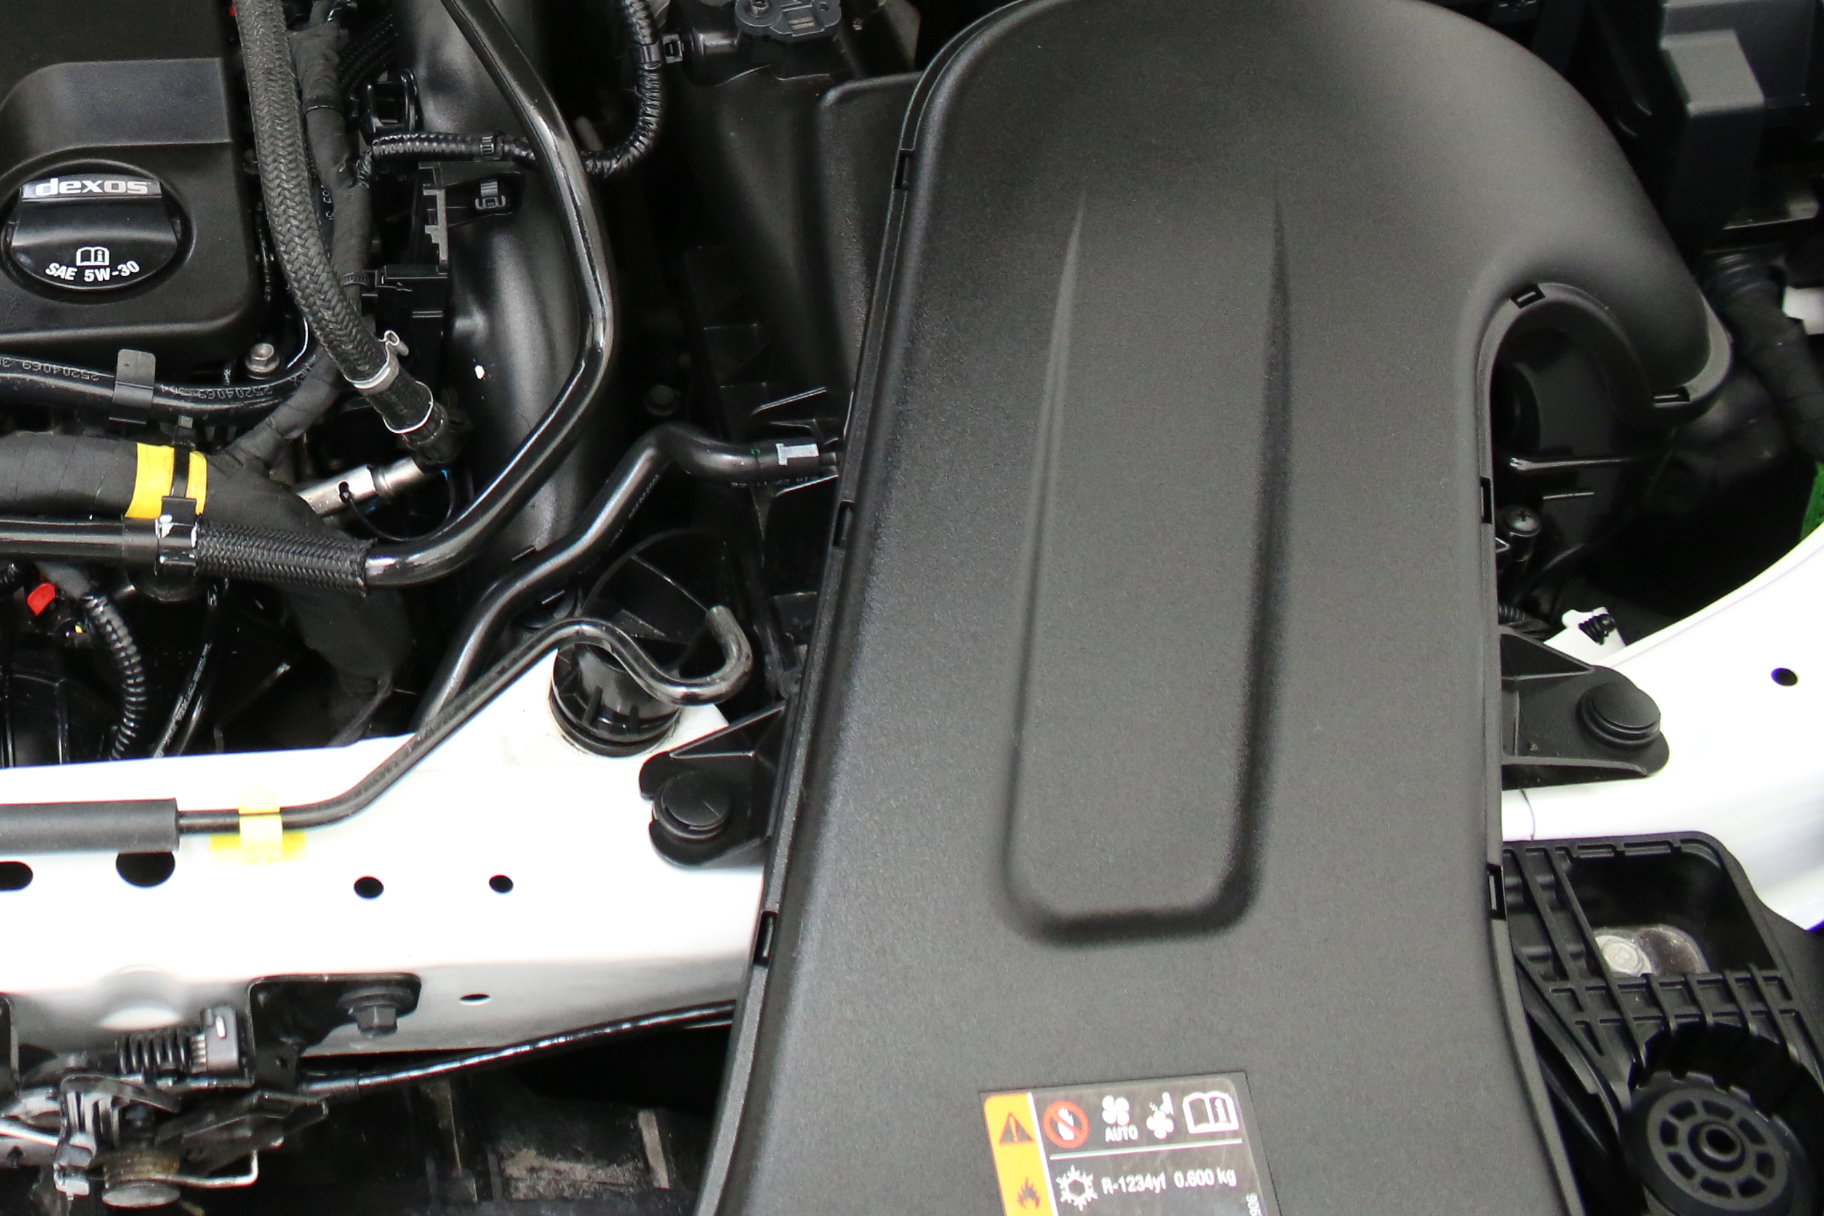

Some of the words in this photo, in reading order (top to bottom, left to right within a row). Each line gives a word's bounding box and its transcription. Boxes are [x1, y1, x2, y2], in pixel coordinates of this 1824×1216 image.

[35, 178, 149, 197] dexos
[45, 262, 78, 281] SAE
[83, 260, 140, 282] 5W-30
[1105, 1125, 1139, 1143] AUTO
[1101, 1171, 1167, 1195] R-1234yf
[1174, 1168, 1215, 1189] 0.600
[1216, 1167, 1238, 1188] kg
